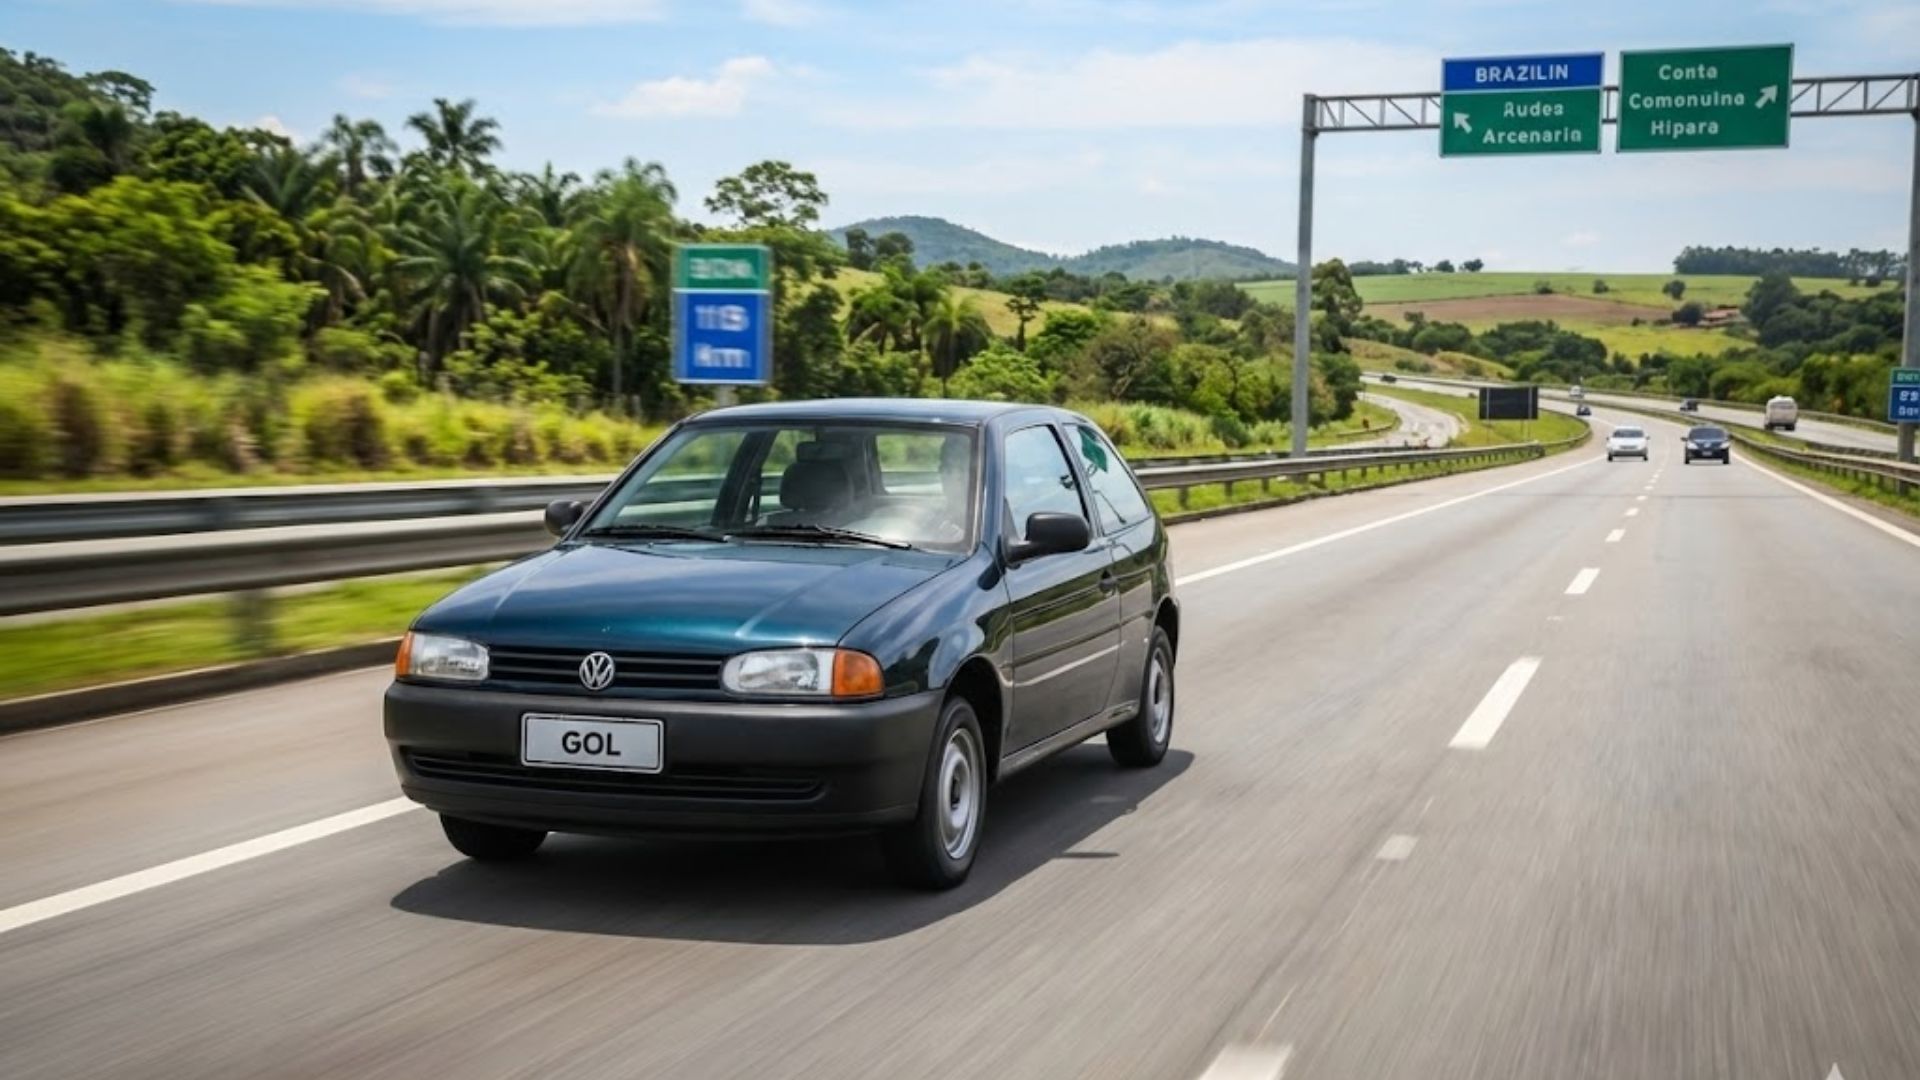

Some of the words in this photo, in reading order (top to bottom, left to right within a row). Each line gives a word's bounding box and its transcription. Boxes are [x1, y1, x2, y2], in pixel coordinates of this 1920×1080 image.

[1475, 64, 1569, 83] BRAZILIN
[1658, 64, 1718, 81] Conta
[1650, 119, 1719, 139] Hipara
[562, 731, 621, 756] GOL
